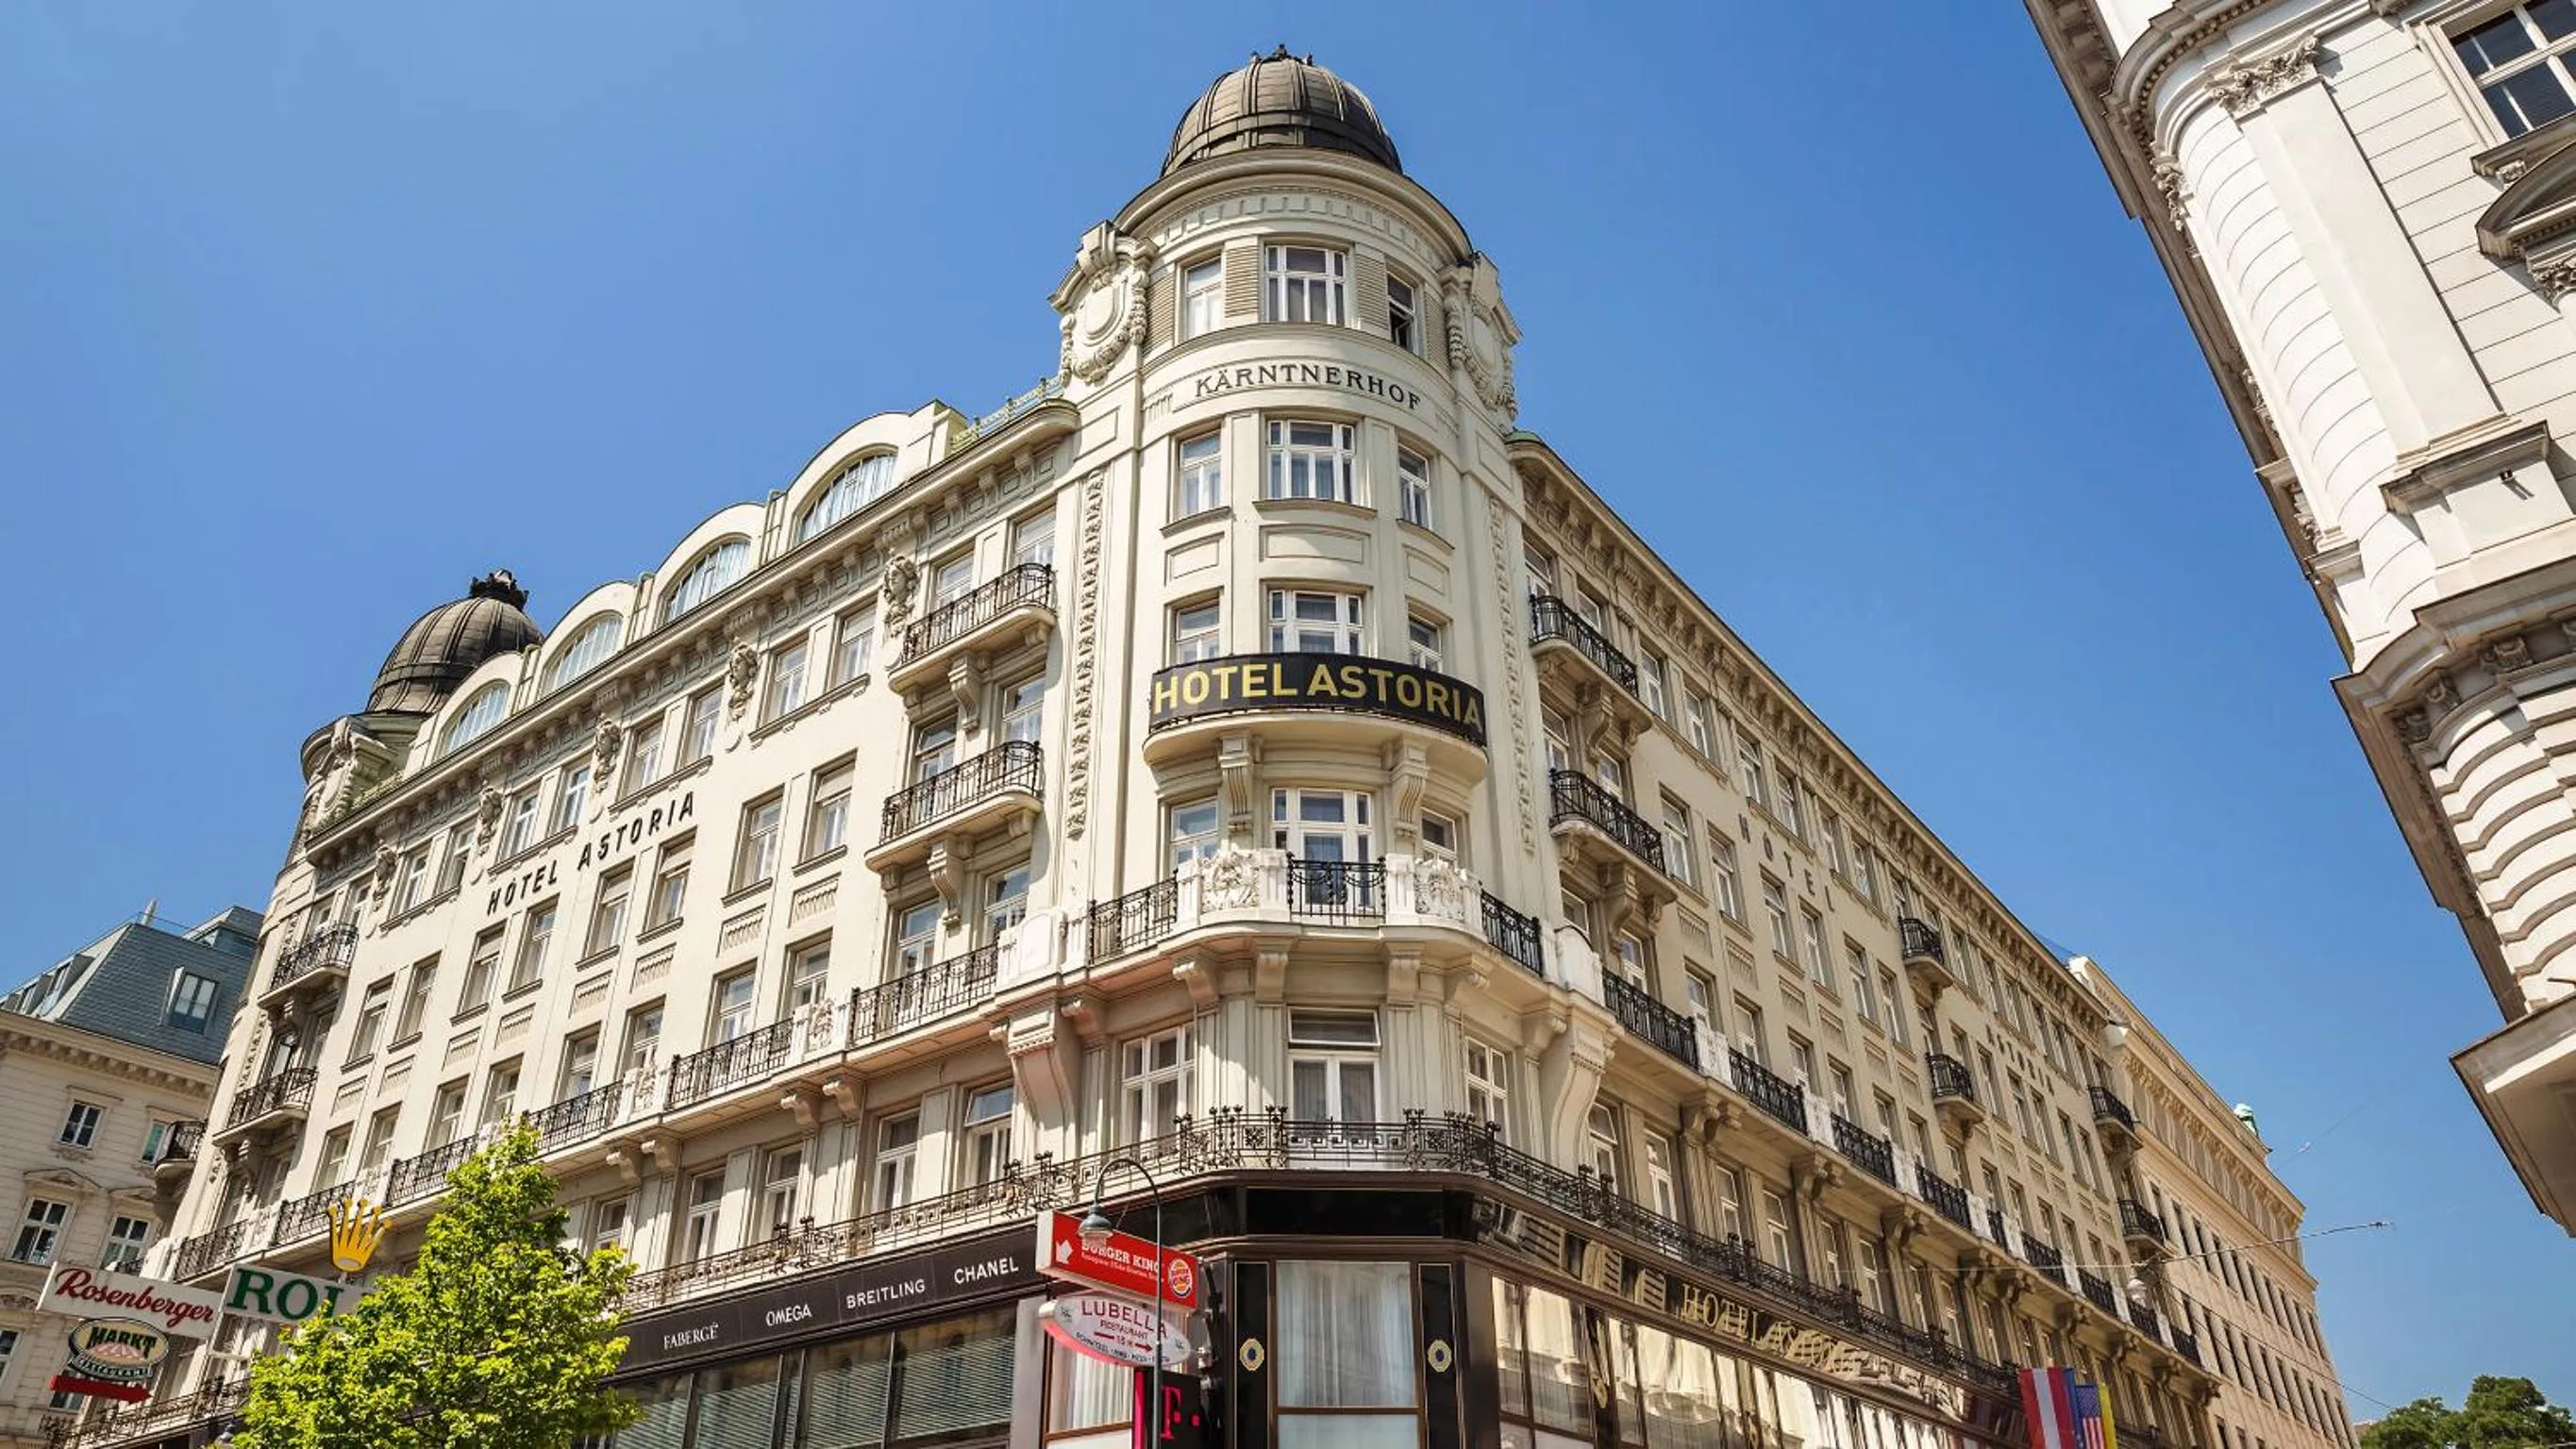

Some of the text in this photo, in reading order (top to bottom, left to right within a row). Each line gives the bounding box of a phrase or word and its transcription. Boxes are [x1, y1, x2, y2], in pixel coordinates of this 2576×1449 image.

[1196, 363, 1421, 409] KÄRNTNERHOF
[1154, 662, 1483, 733] HOTEL ASTORIA
[577, 791, 694, 872] ASTORIA
[954, 1257, 1019, 1285] CHANEL
[55, 1268, 213, 1328] Rosenberger
[226, 1268, 351, 1323] ROL
[845, 1278, 926, 1309] BREITLING
[765, 1304, 812, 1326] OMEGA
[1081, 1301, 1166, 1338] LUBELLA
[1100, 1320, 1148, 1340] RESTAURANT
[85, 1326, 158, 1359] MARKT
